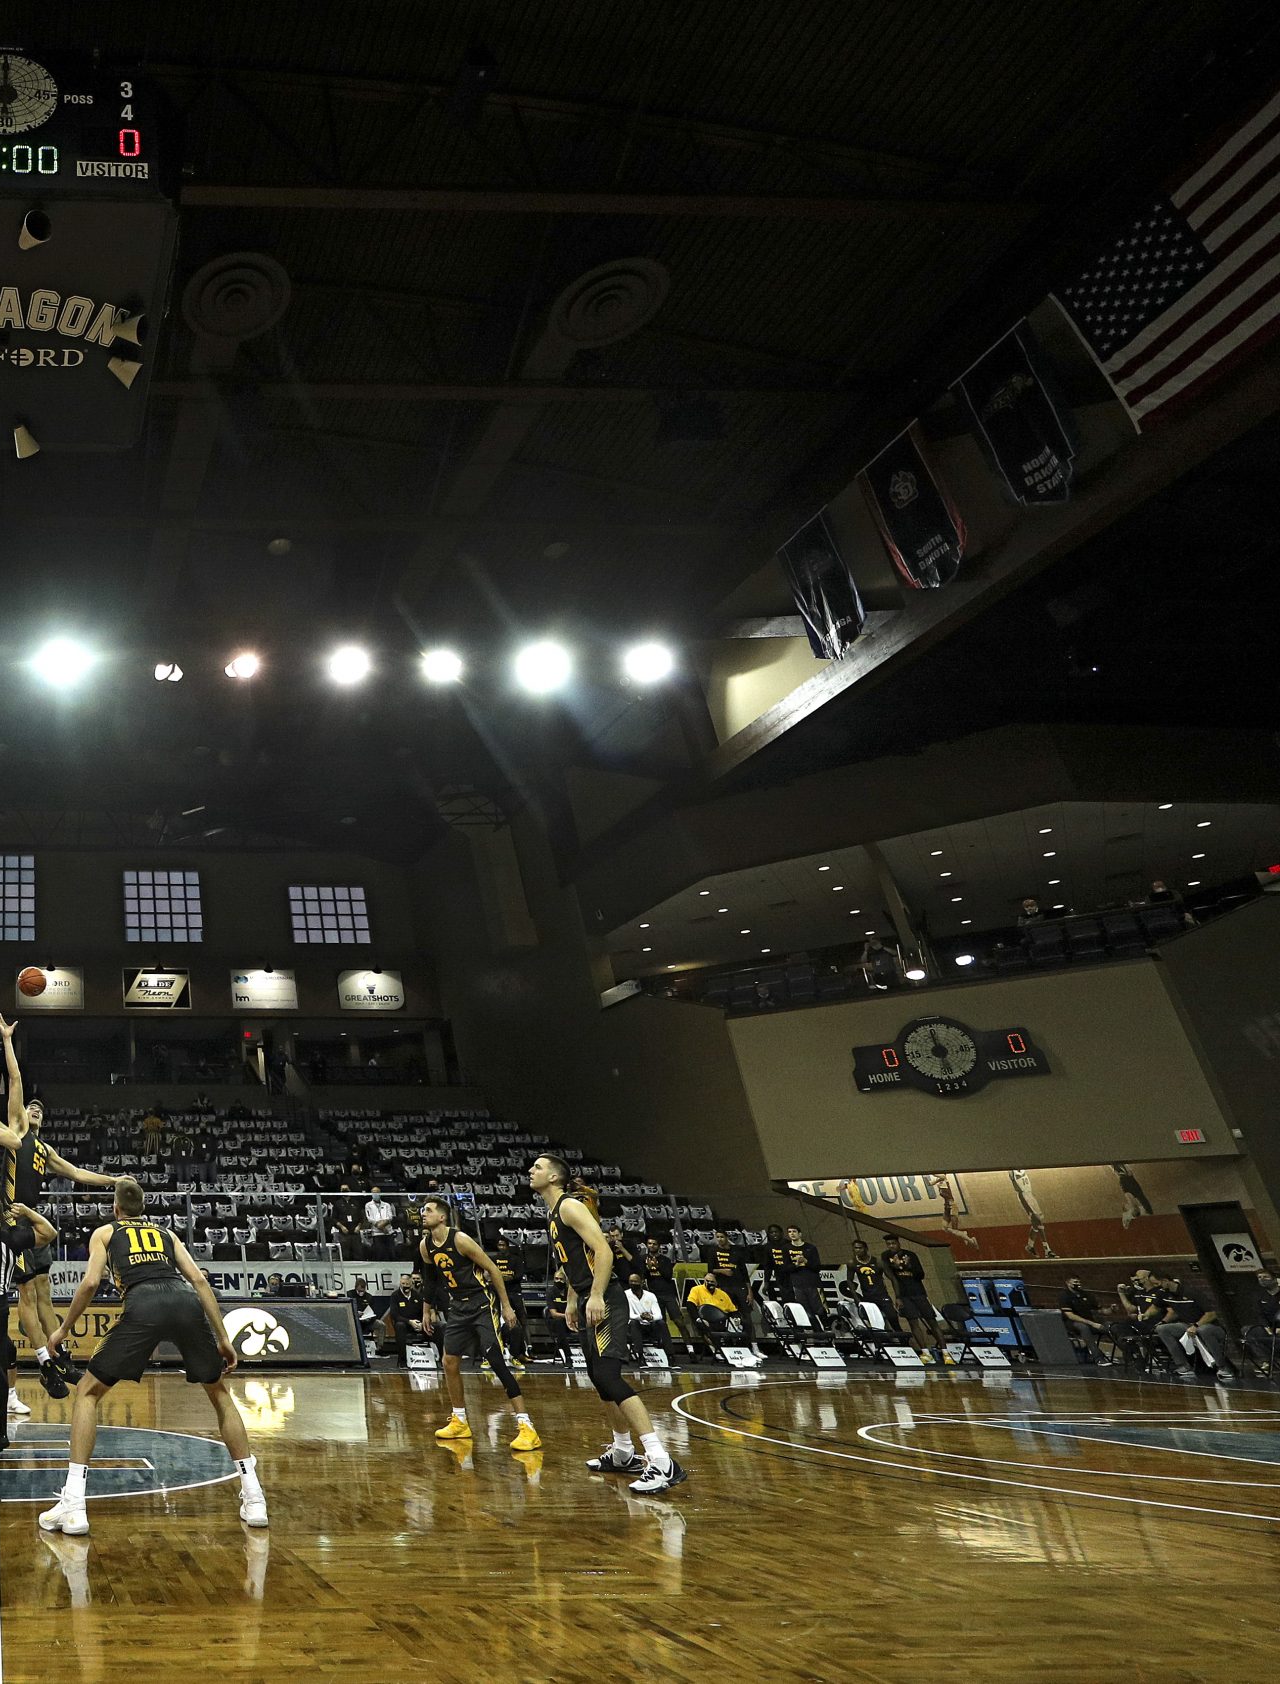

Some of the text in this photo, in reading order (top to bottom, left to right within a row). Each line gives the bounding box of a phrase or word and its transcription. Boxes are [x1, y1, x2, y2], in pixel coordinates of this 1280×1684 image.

[34, 90, 51, 101] 45
[120, 81, 133, 98] 3
[63, 94, 94, 105] POSS
[120, 104, 134, 121] 4
[119, 128, 141, 156] 0
[79, 162, 147, 178] VISITOR
[138, 989, 174, 997] Neon
[1007, 1033, 1026, 1054] 0
[882, 1048, 900, 1068] 0
[987, 1057, 1037, 1072] VISITOR
[868, 1072, 901, 1084] HOME
[1180, 1129, 1201, 1142] EXIT
[32, 1151, 46, 1176] 55
[125, 1227, 165, 1253] 10
[128, 1252, 169, 1265] EQUALITY
[350, 1273, 394, 1291] THE
[442, 1270, 458, 1288] 3
[867, 1275, 874, 1286] 1
